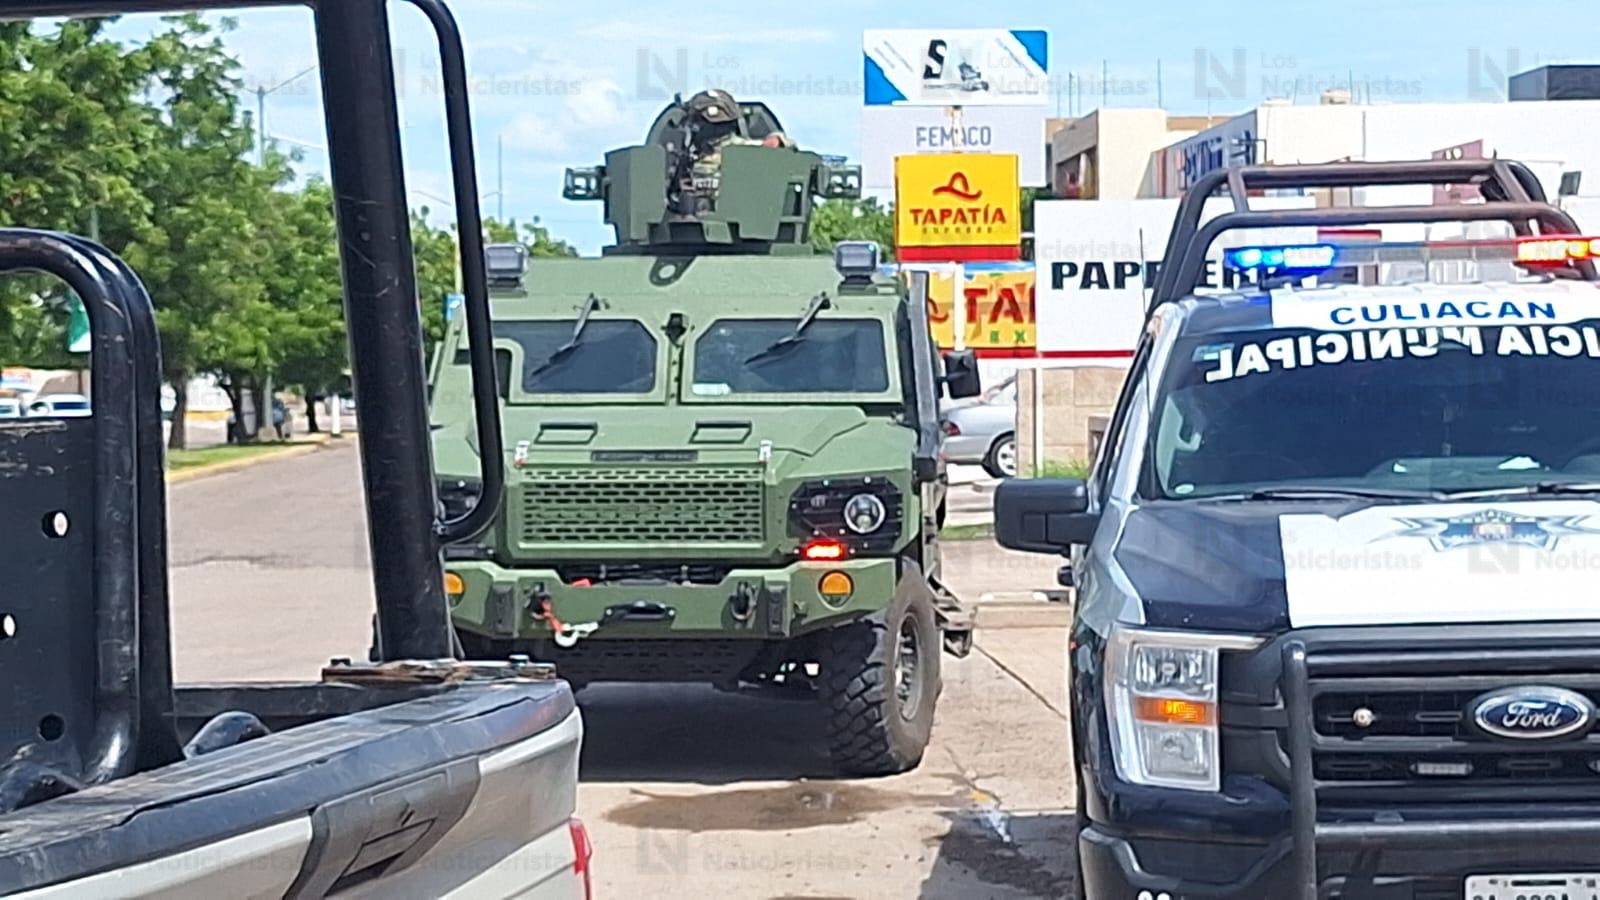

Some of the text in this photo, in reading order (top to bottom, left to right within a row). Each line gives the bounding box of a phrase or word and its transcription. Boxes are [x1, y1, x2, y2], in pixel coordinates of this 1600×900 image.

[909, 203, 1007, 225] TAPATÍA
[1330, 300, 1557, 326] CULIACAN
[1501, 702, 1563, 729] Ford
